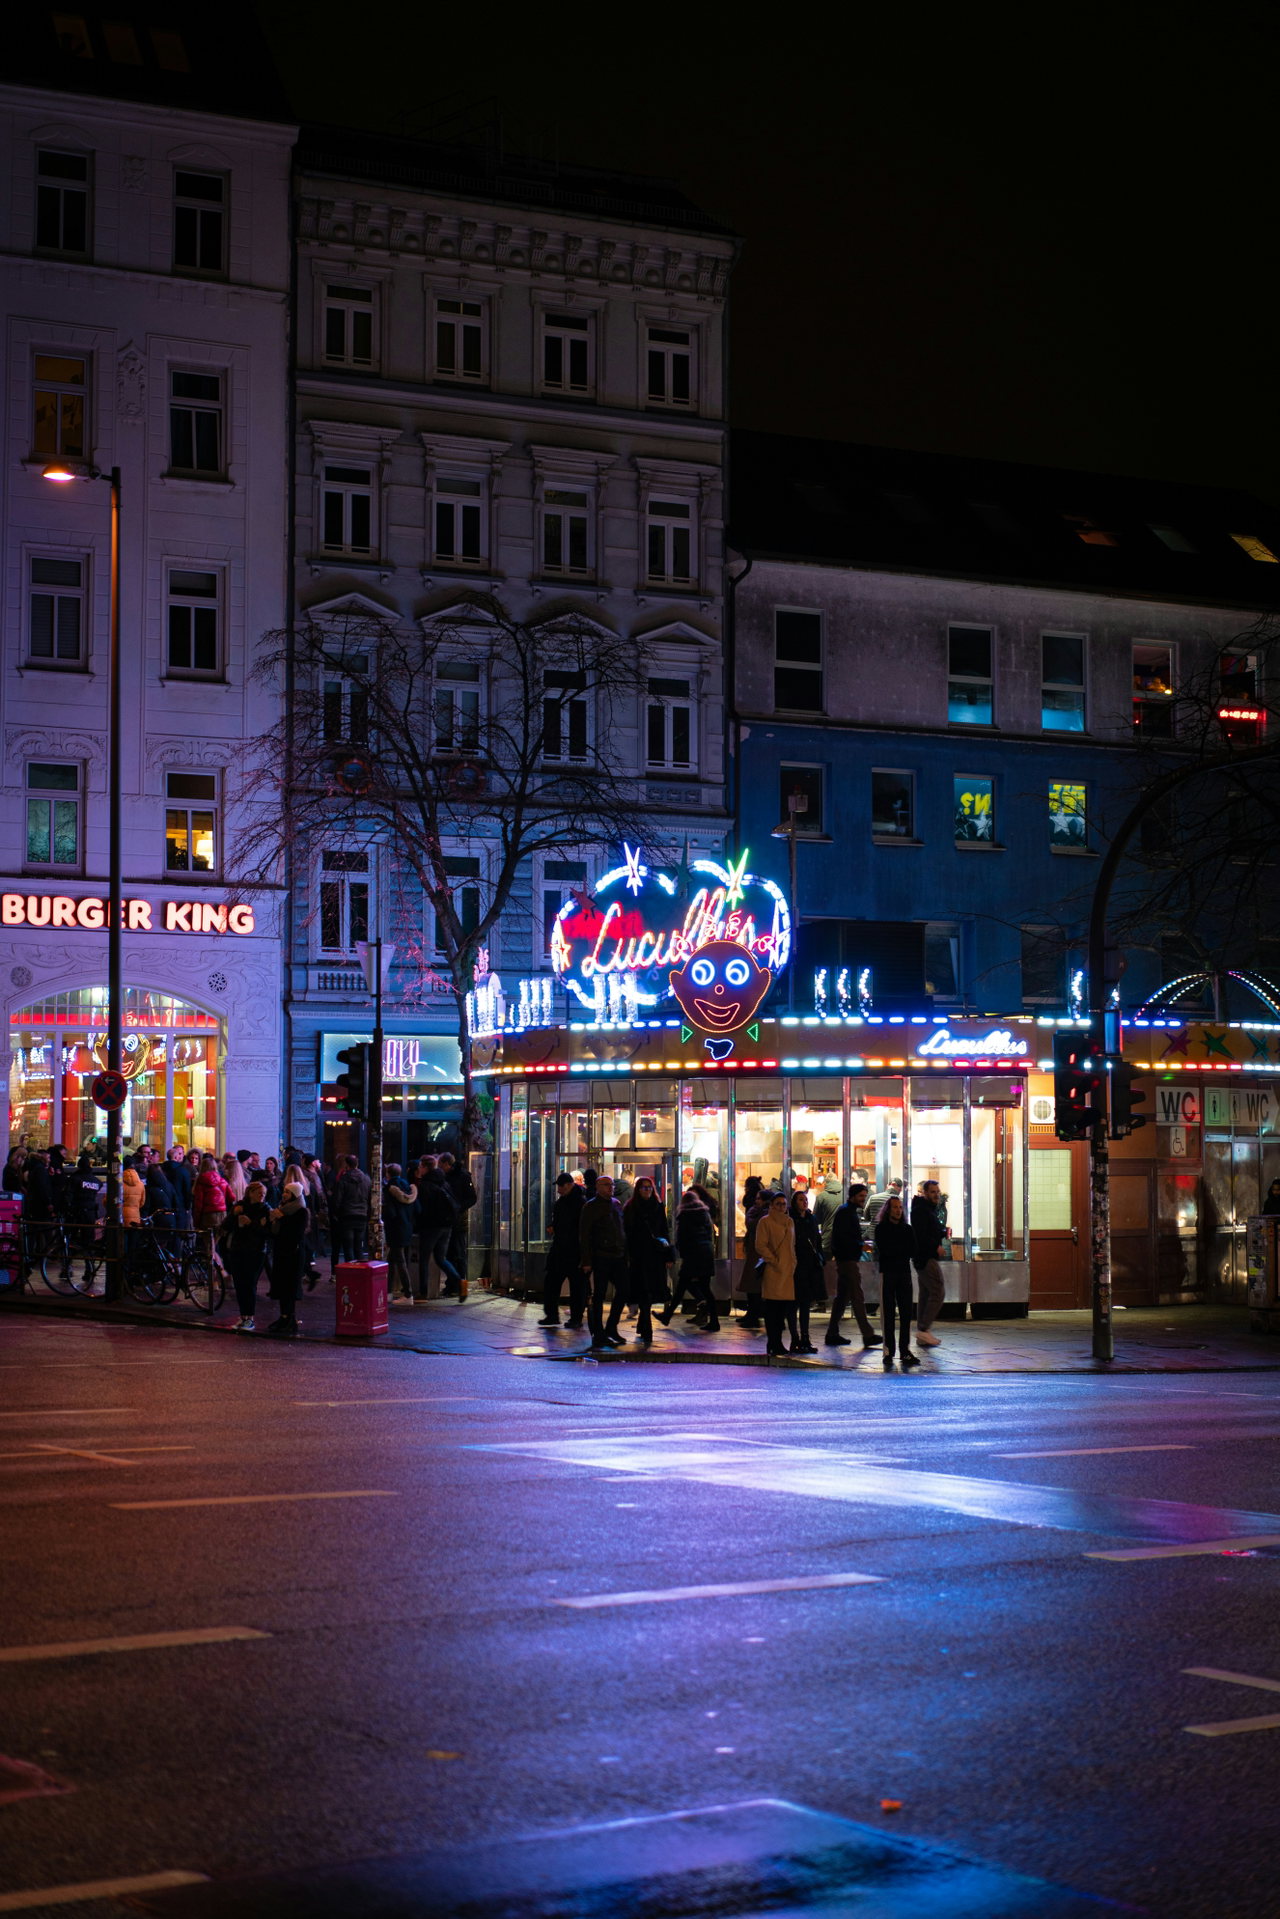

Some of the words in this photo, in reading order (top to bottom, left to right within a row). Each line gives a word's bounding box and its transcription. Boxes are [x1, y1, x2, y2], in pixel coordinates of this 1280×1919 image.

[165, 901, 255, 934] KING
[386, 1039, 420, 1078] OLY
[1160, 1091, 1197, 1122] WC
[1247, 1093, 1269, 1121] WC
